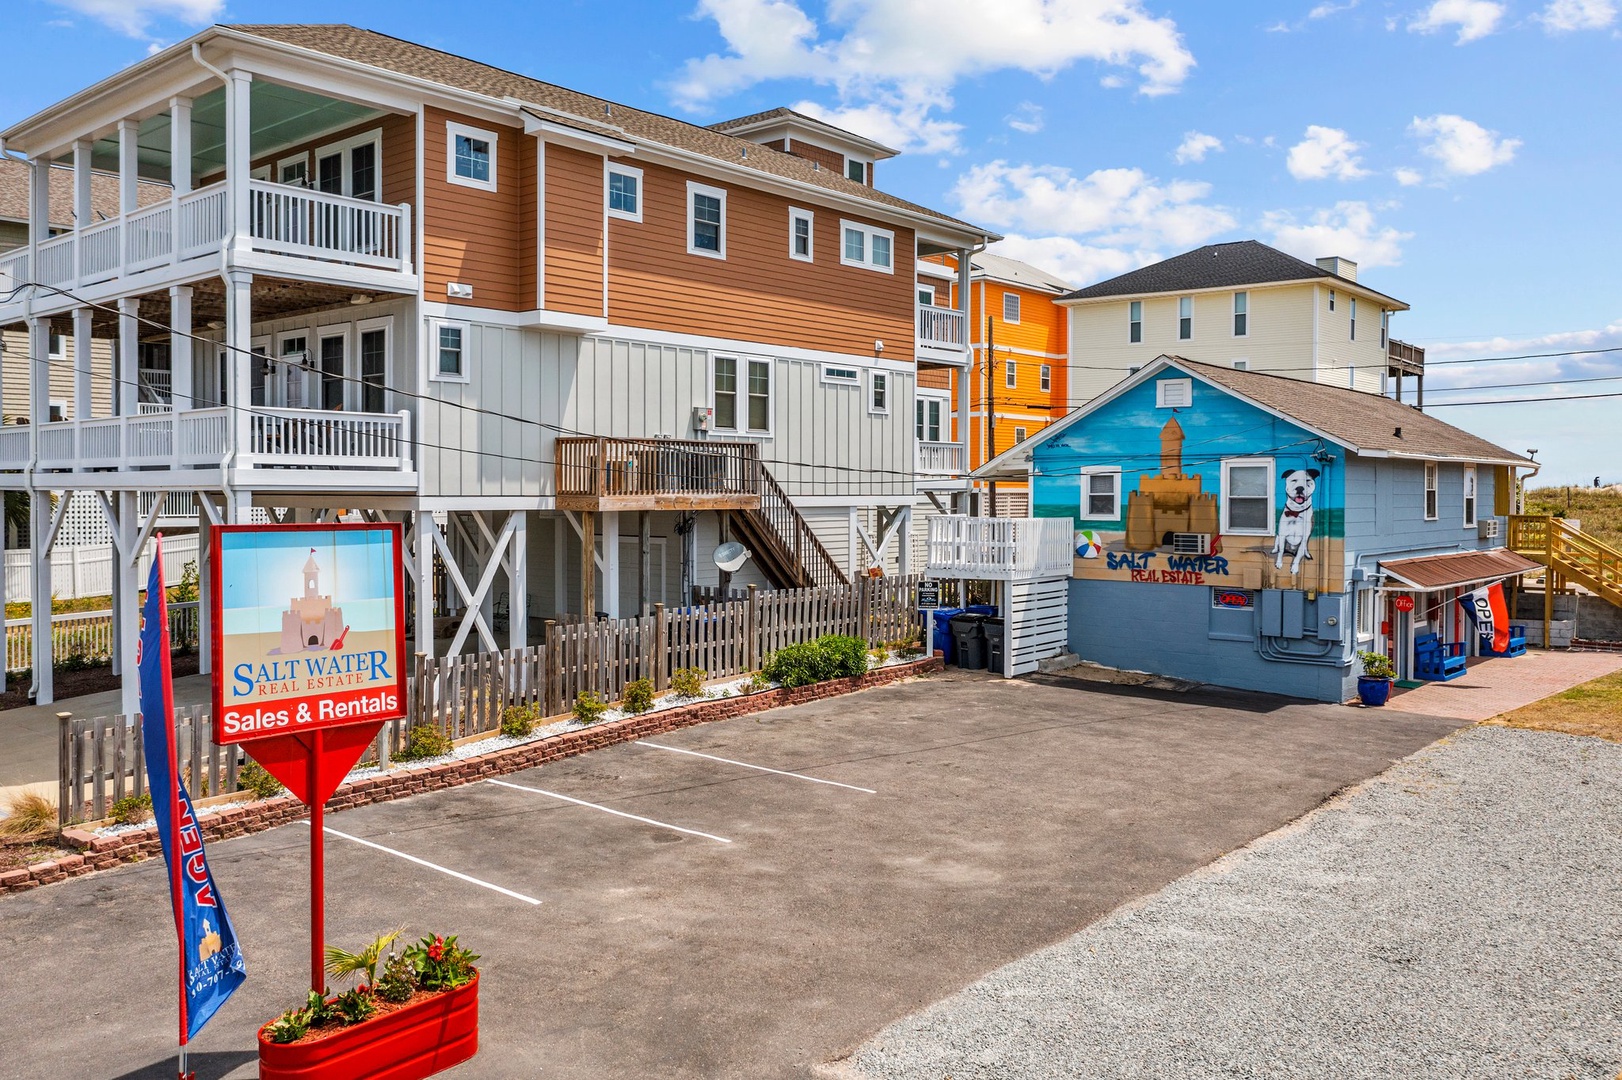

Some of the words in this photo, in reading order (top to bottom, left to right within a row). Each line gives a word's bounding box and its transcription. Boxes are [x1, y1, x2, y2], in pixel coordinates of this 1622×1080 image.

[1106, 551, 1156, 570] SALT
[1167, 555, 1229, 576] WATER
[1131, 569, 1159, 583] REAL
[1161, 570, 1205, 585] ESTATE
[1220, 593, 1247, 606] OPEN
[1395, 599, 1413, 609] Office
[233, 659, 300, 697] SALT
[305, 650, 392, 681] WATER
[258, 681, 300, 696] REAL
[307, 673, 364, 690] ESTATE
[224, 709, 289, 734] Sales
[295, 703, 312, 723] &
[319, 692, 398, 720] Rentals
[178, 783, 217, 908] AGEN
